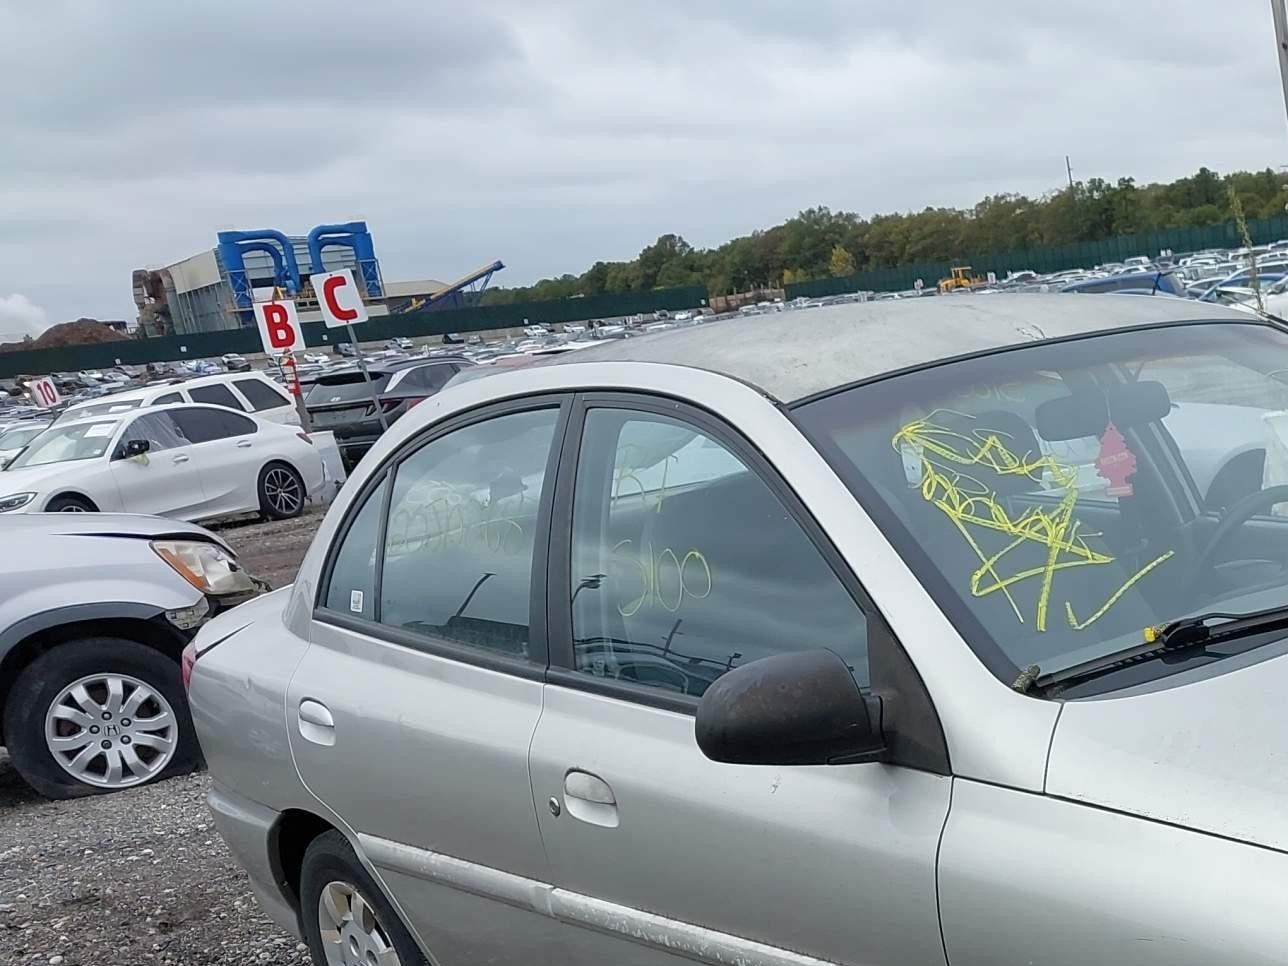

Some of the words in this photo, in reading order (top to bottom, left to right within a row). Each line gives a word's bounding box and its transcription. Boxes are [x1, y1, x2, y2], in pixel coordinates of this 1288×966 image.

[323, 275, 358, 321] C
[262, 303, 296, 348] B
[36, 381, 57, 406] 10
